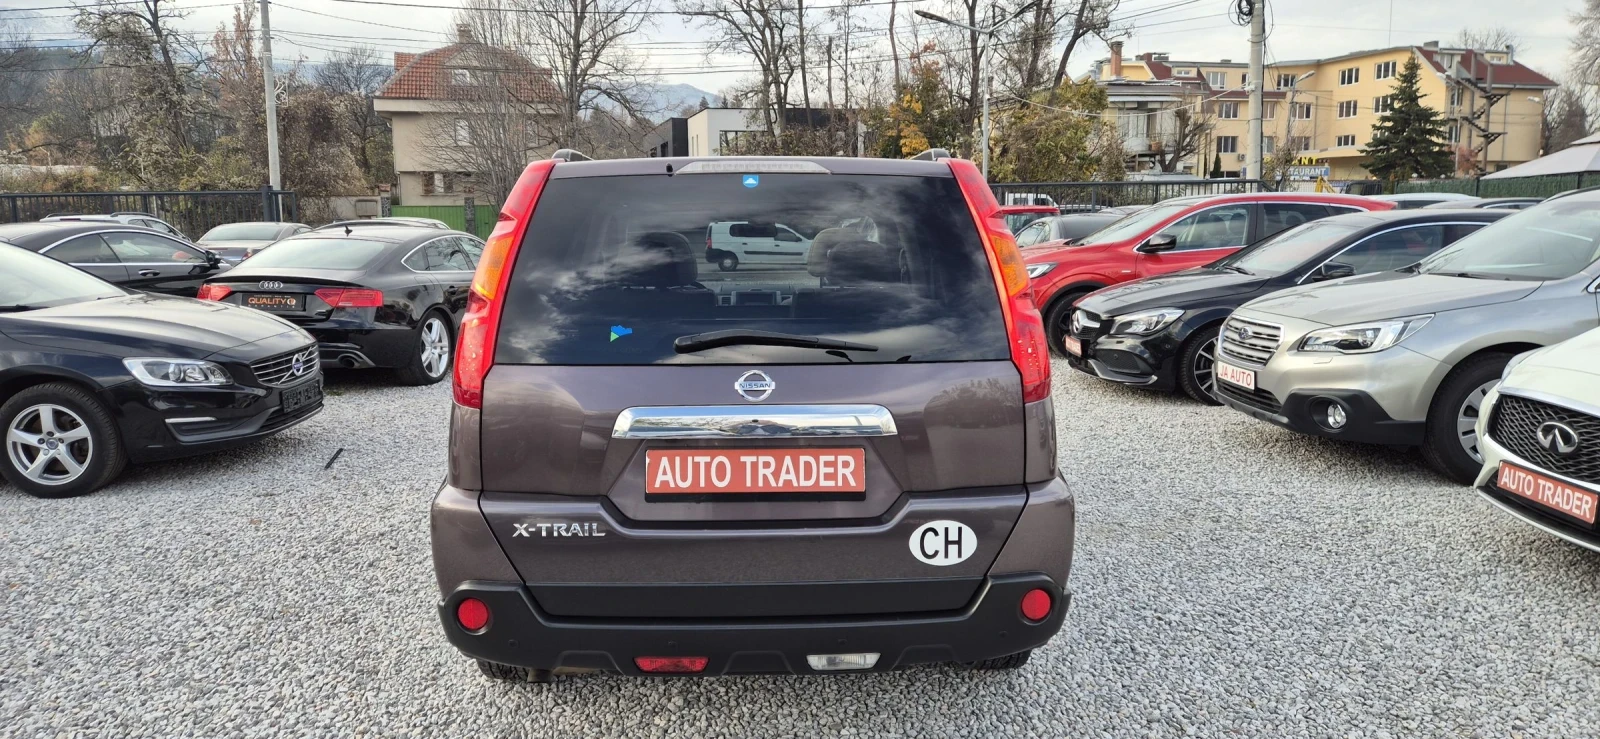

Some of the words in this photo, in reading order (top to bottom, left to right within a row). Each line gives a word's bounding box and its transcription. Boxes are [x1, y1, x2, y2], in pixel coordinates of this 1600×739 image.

[248, 297, 287, 305] QUALITY
[1220, 365, 1229, 379] JA
[1230, 368, 1252, 386] AUTO
[654, 455, 732, 488] AUTO
[740, 455, 857, 487] TRADER
[1501, 467, 1534, 496] AUTO
[1537, 479, 1592, 519] TRADER
[512, 522, 607, 538] X-TRAIL
[919, 526, 963, 560] CH
